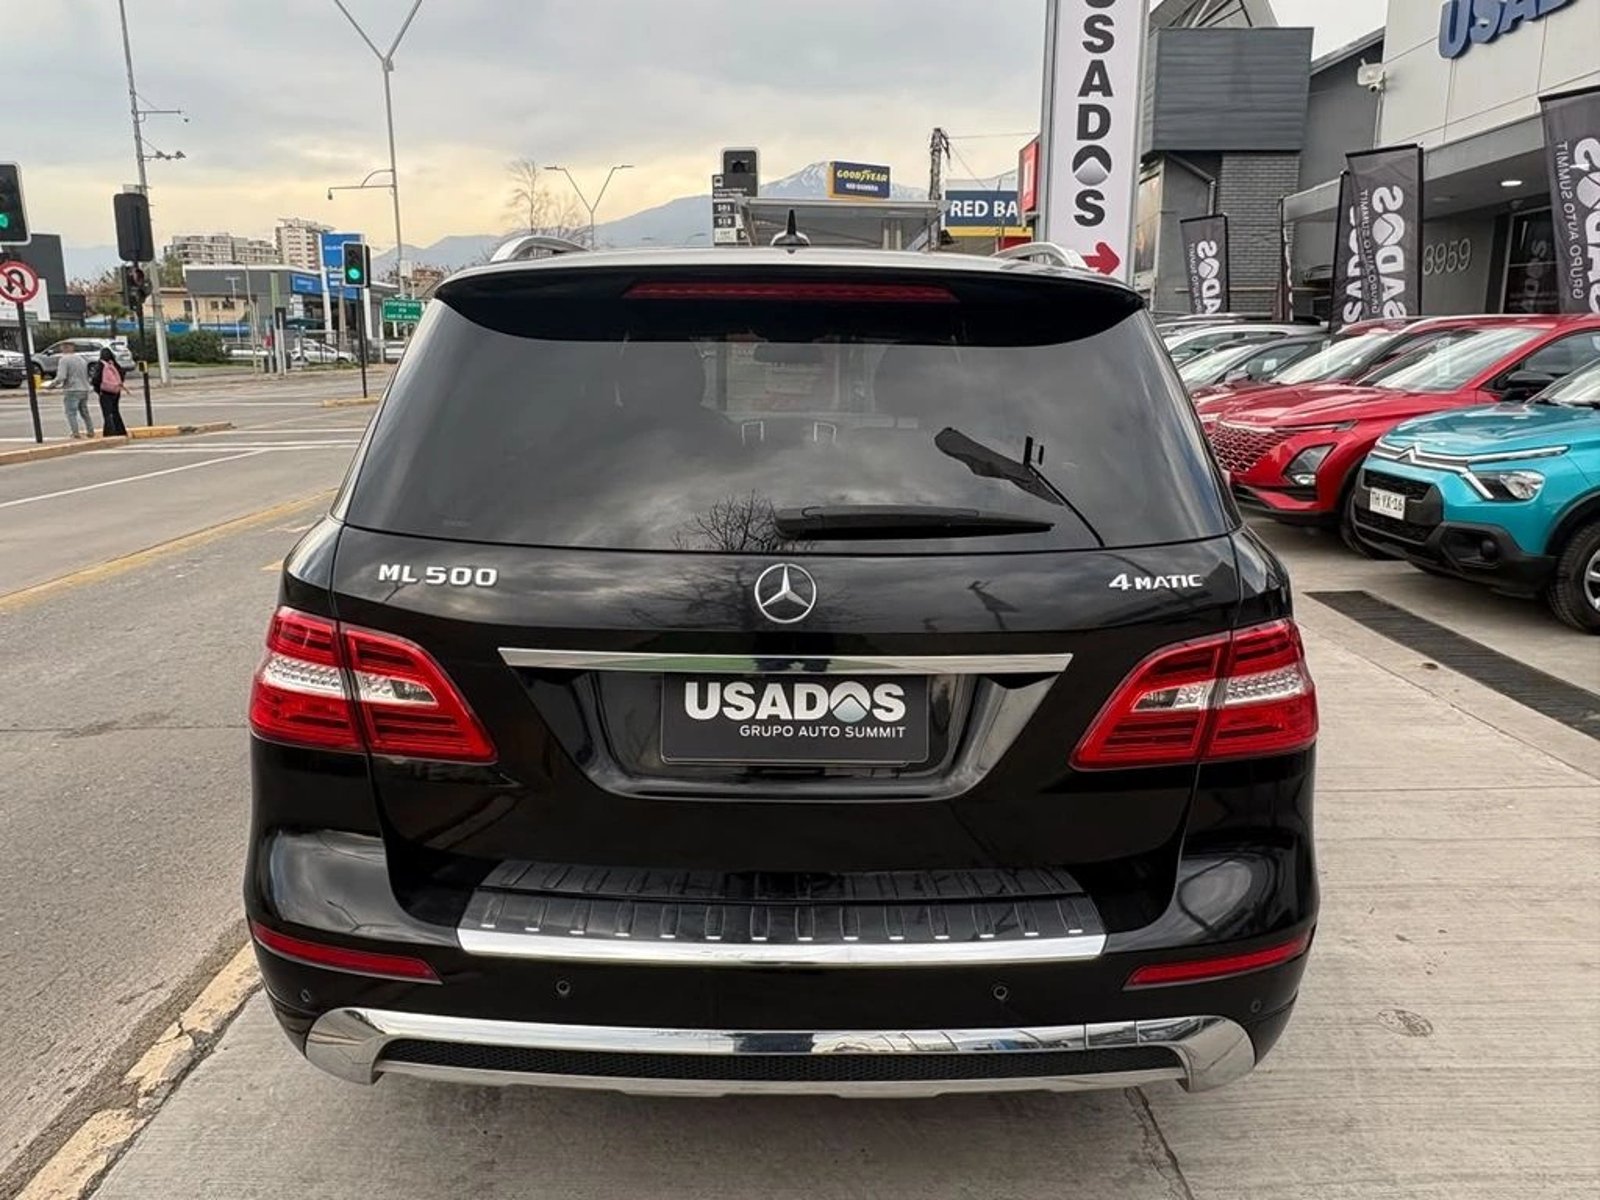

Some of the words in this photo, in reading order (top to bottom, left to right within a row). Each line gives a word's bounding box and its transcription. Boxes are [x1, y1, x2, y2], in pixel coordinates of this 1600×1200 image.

[1072, 0, 1117, 227] SADOS
[950, 200, 989, 217] RED
[1423, 238, 1471, 276] 8959
[378, 564, 417, 582] ML
[425, 567, 498, 586] 500
[685, 681, 906, 723] USADOS
[740, 725, 794, 738] GRUPO
[798, 725, 840, 738] AUTO
[845, 726, 907, 739] SUMMIT
